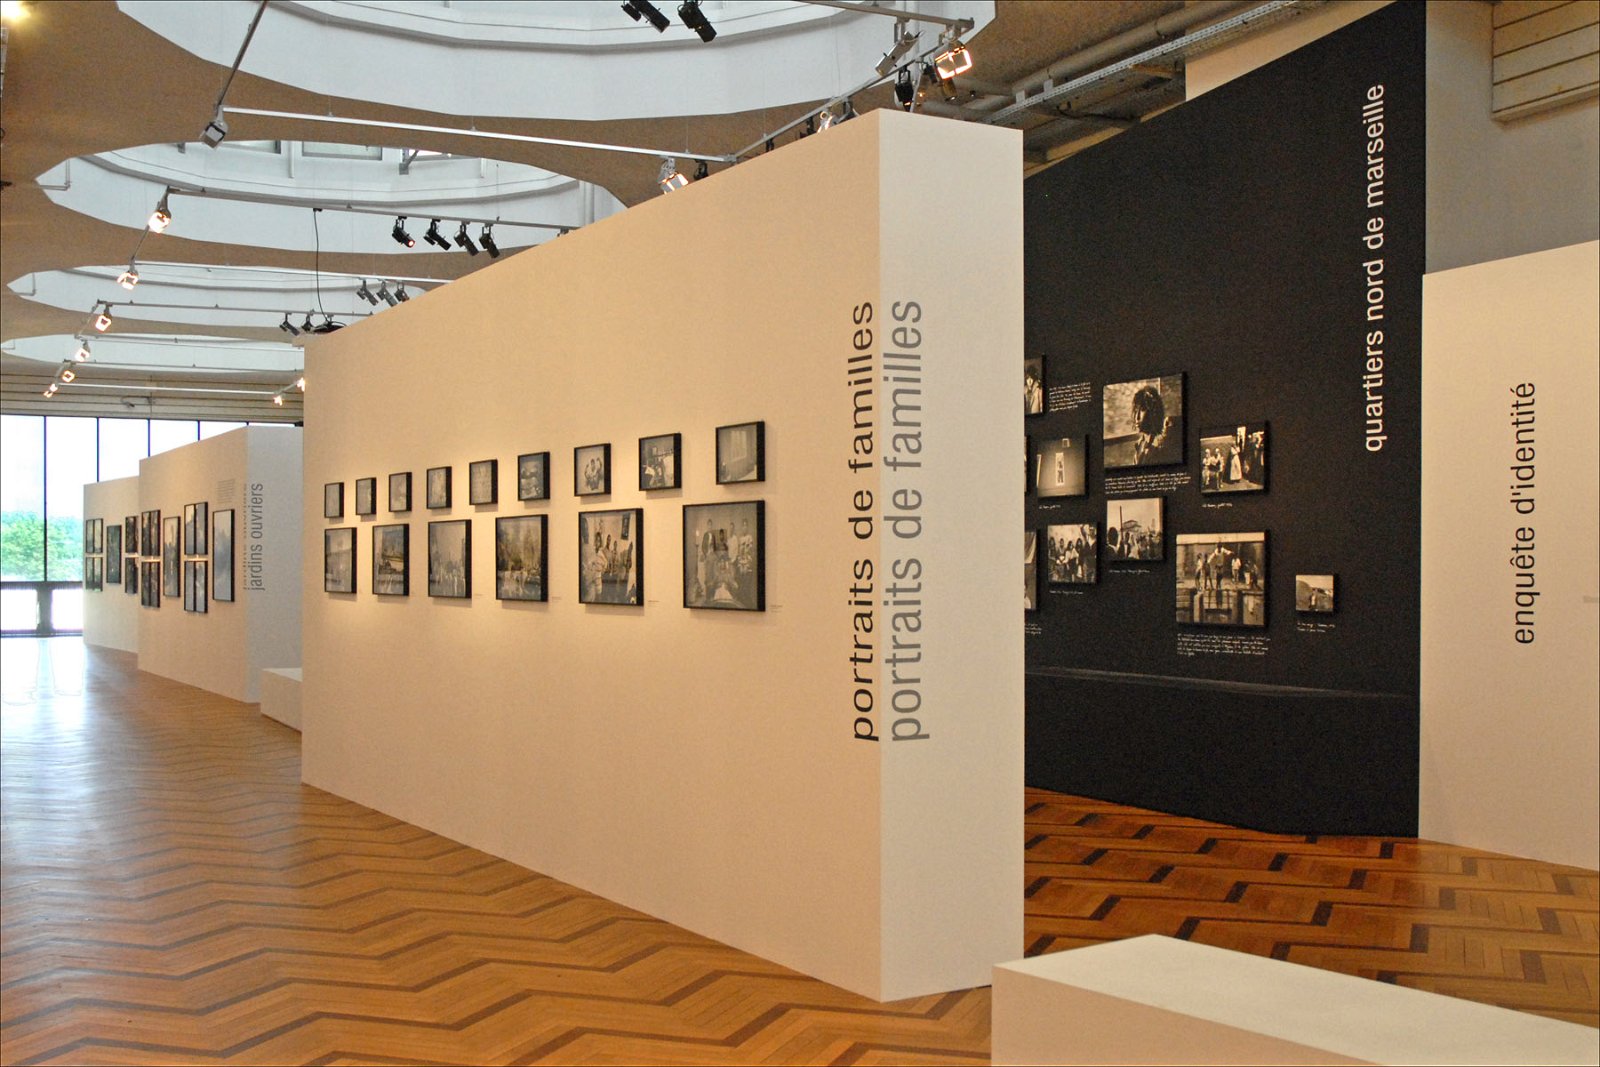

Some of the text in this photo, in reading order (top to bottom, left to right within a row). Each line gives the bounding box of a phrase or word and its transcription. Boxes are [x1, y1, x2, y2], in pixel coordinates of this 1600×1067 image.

[1362, 84, 1388, 452] quartiers nord de marseille
[248, 483, 266, 591] jardins ouvriers
[847, 301, 879, 743] portraits de familles
[882, 301, 931, 743] portraits de familles
[1509, 382, 1541, 645] enquête d'identité
